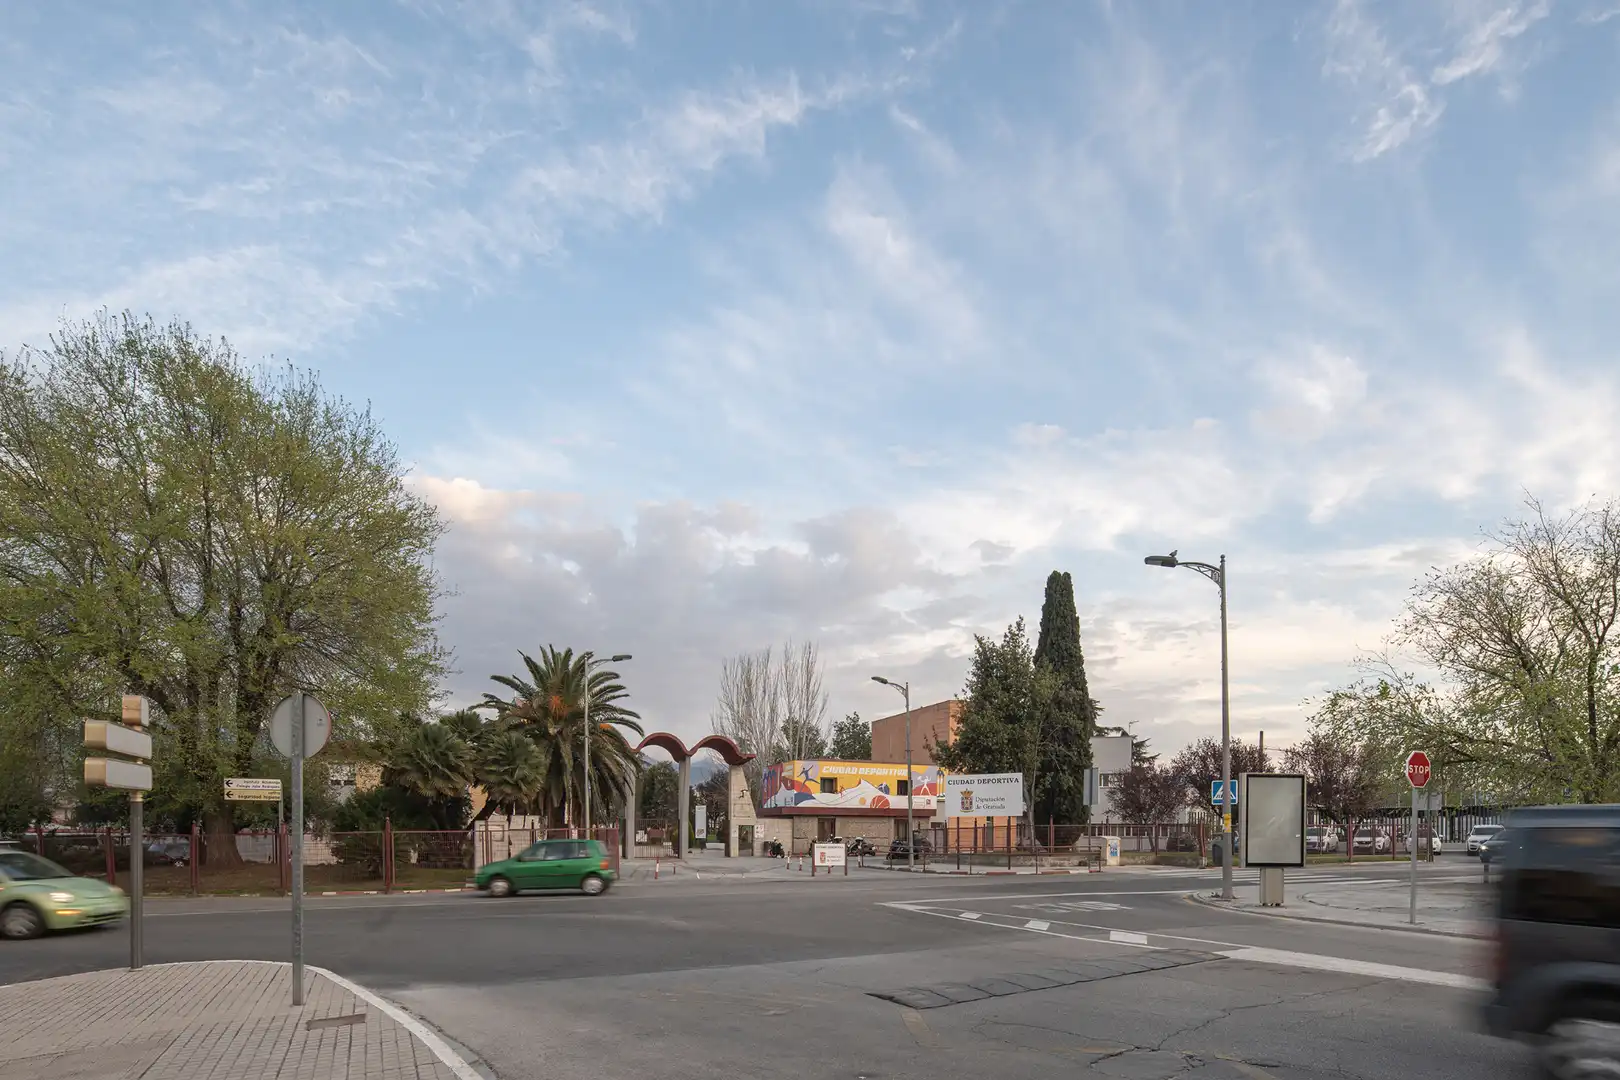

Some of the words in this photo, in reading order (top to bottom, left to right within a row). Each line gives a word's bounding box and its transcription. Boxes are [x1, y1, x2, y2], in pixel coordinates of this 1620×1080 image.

[822, 765, 857, 775] CIUDAD
[1409, 765, 1430, 774] STOP
[977, 777, 1020, 785] DEPORTIVA
